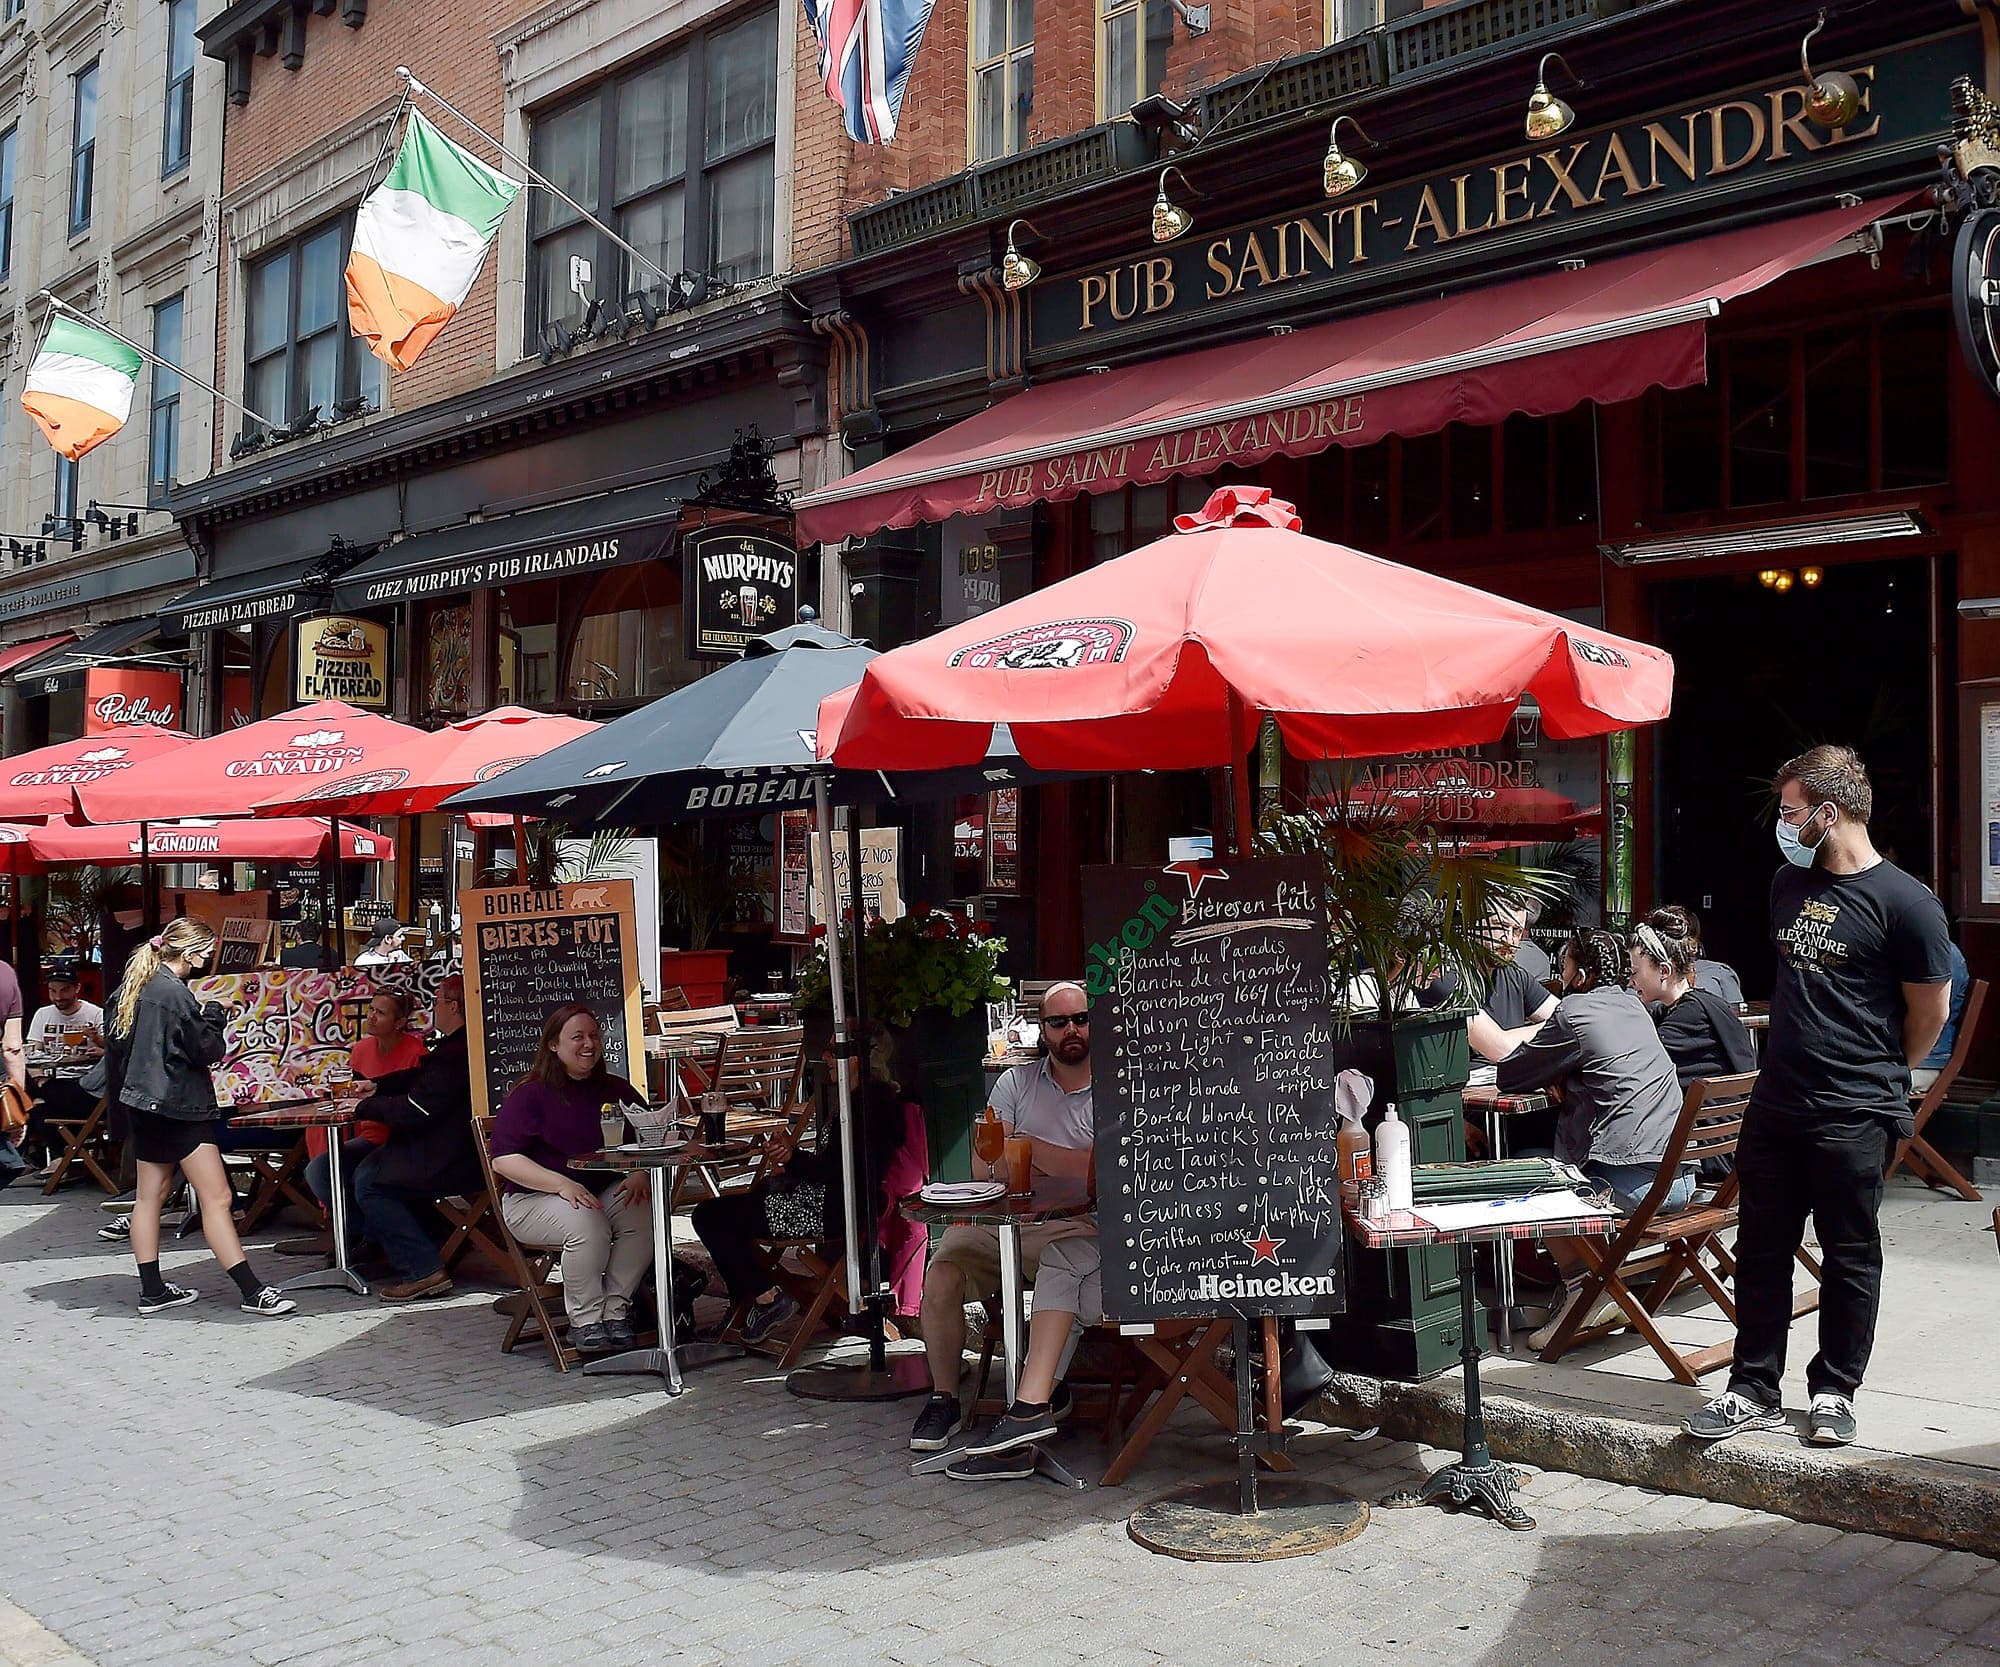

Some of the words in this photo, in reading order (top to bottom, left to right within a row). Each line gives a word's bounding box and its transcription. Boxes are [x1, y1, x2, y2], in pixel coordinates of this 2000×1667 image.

[1078, 256, 1177, 331] PUB
[1205, 64, 1881, 300] SAINT-ALEXANDRE
[976, 464, 1034, 502] PUB
[1043, 443, 1135, 491] SAINT
[1145, 394, 1366, 473] ALEXANDRE
[366, 579, 404, 601] CHEZ
[404, 565, 484, 594] MURPHY'S
[487, 558, 521, 581] PUB
[524, 539, 620, 575] IRLANDAIS
[182, 605, 230, 630] PIZZERIA
[231, 594, 296, 621] FLATBREAD
[315, 659, 372, 677] PIZZERIA
[305, 676, 382, 698] FLATBREAD
[262, 747, 363, 760] MOLSON
[48, 761, 134, 772] MOLSON
[872, 849, 893, 863] NOS
[483, 921, 560, 950] BIÈRES
[560, 928, 572, 936] EN
[574, 917, 615, 944] FÛT
[1793, 918, 1832, 937] SAINT
[1119, 946, 1183, 970] Blanche
[1190, 948, 1210, 965] du
[1220, 936, 1286, 962] Paradis
[1793, 943, 1818, 959] PUB
[534, 963, 545, 975] de
[1118, 966, 1184, 996] Blanche
[1190, 966, 1210, 988] de
[1122, 987, 1225, 1020] Kronenbourg
[1235, 983, 1269, 1007] 1664
[1126, 1015, 1188, 1038] Molson
[1198, 1007, 1290, 1029] Canadian
[1127, 1040, 1171, 1057] Coors
[1180, 1030, 1234, 1056] Light
[1260, 1030, 1294, 1050] Fin
[1304, 1023, 1331, 1044] du
[1253, 1047, 1324, 1067] monde
[1255, 1061, 1312, 1083] blonde
[1131, 1079, 1182, 1104] Harp
[1188, 1076, 1241, 1097] blonde
[1276, 1076, 1330, 1100] triple
[1201, 1102, 1257, 1125] blonde
[1267, 1101, 1302, 1125] IPA
[1130, 1126, 1260, 1147] Smithwick's
[1133, 1147, 1175, 1172] Mac
[1176, 1147, 1246, 1168] Tavish
[1133, 1171, 1174, 1199] New
[1183, 1171, 1247, 1193] Castle
[1272, 1171, 1294, 1187] La
[1299, 1165, 1333, 1188] Mer
[1299, 1184, 1333, 1206] IPA
[1139, 1226, 1201, 1251] Griffon
[1210, 1228, 1253, 1245] rousse
[1142, 1257, 1182, 1278] Cidre
[1188, 1250, 1237, 1274] minot
[1198, 1272, 1336, 1299] Heineken
